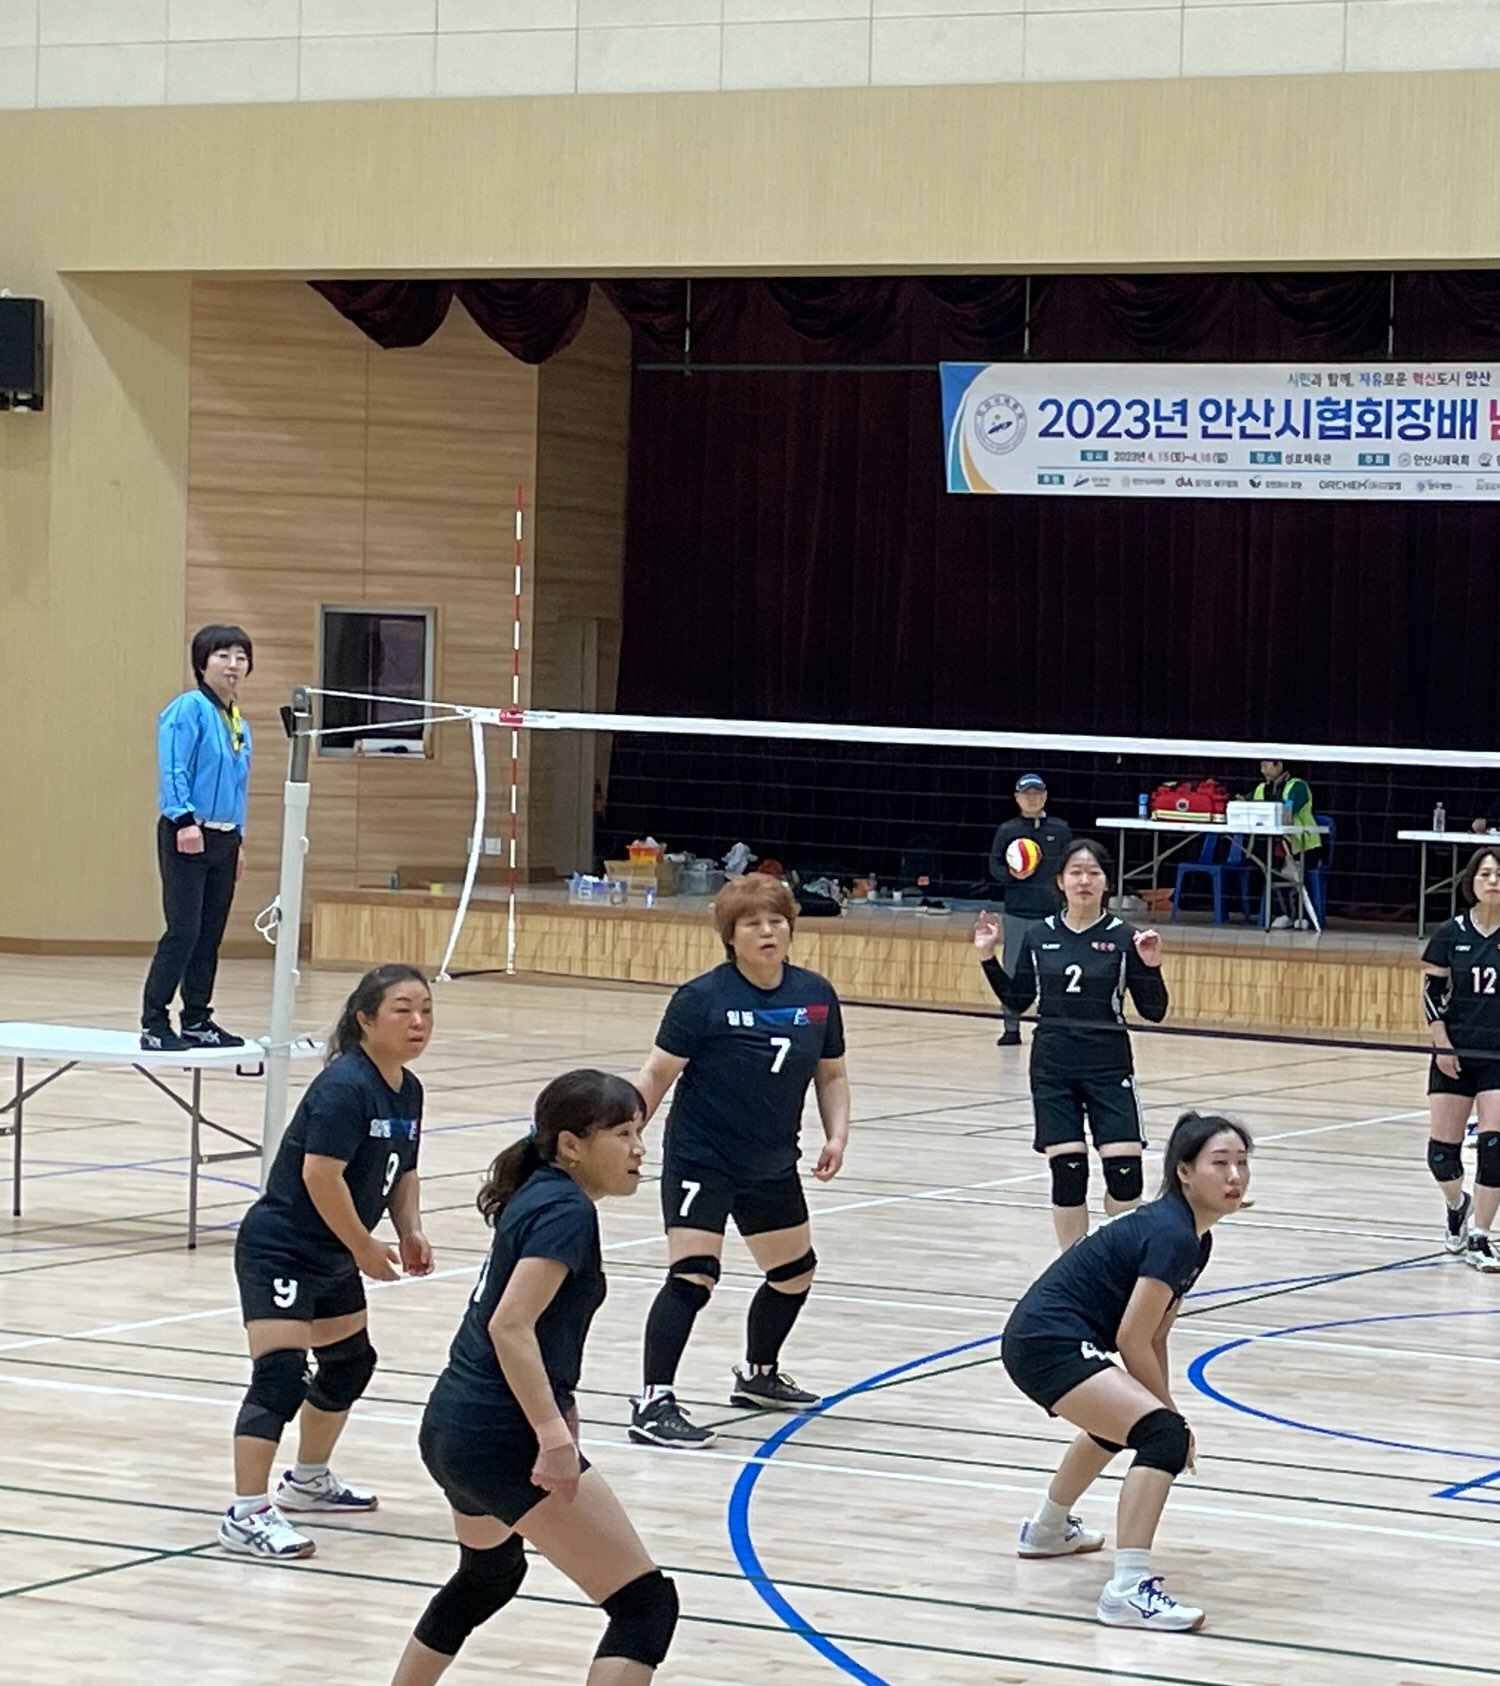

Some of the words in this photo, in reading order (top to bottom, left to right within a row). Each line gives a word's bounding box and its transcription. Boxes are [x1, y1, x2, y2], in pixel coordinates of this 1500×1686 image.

[1359, 372, 1407, 387] 자유로운
[1413, 372, 1460, 388] 혁신도시
[1465, 371, 1491, 387] 안산
[1038, 398, 1188, 440] 2023년
[1197, 396, 1478, 441] 안산시협회장배
[1065, 964, 1082, 993] 2
[1472, 966, 1497, 994] 12
[770, 1037, 792, 1073] 7
[382, 1152, 400, 1197] 9
[679, 1180, 701, 1217] 7
[273, 1278, 299, 1308] 9
